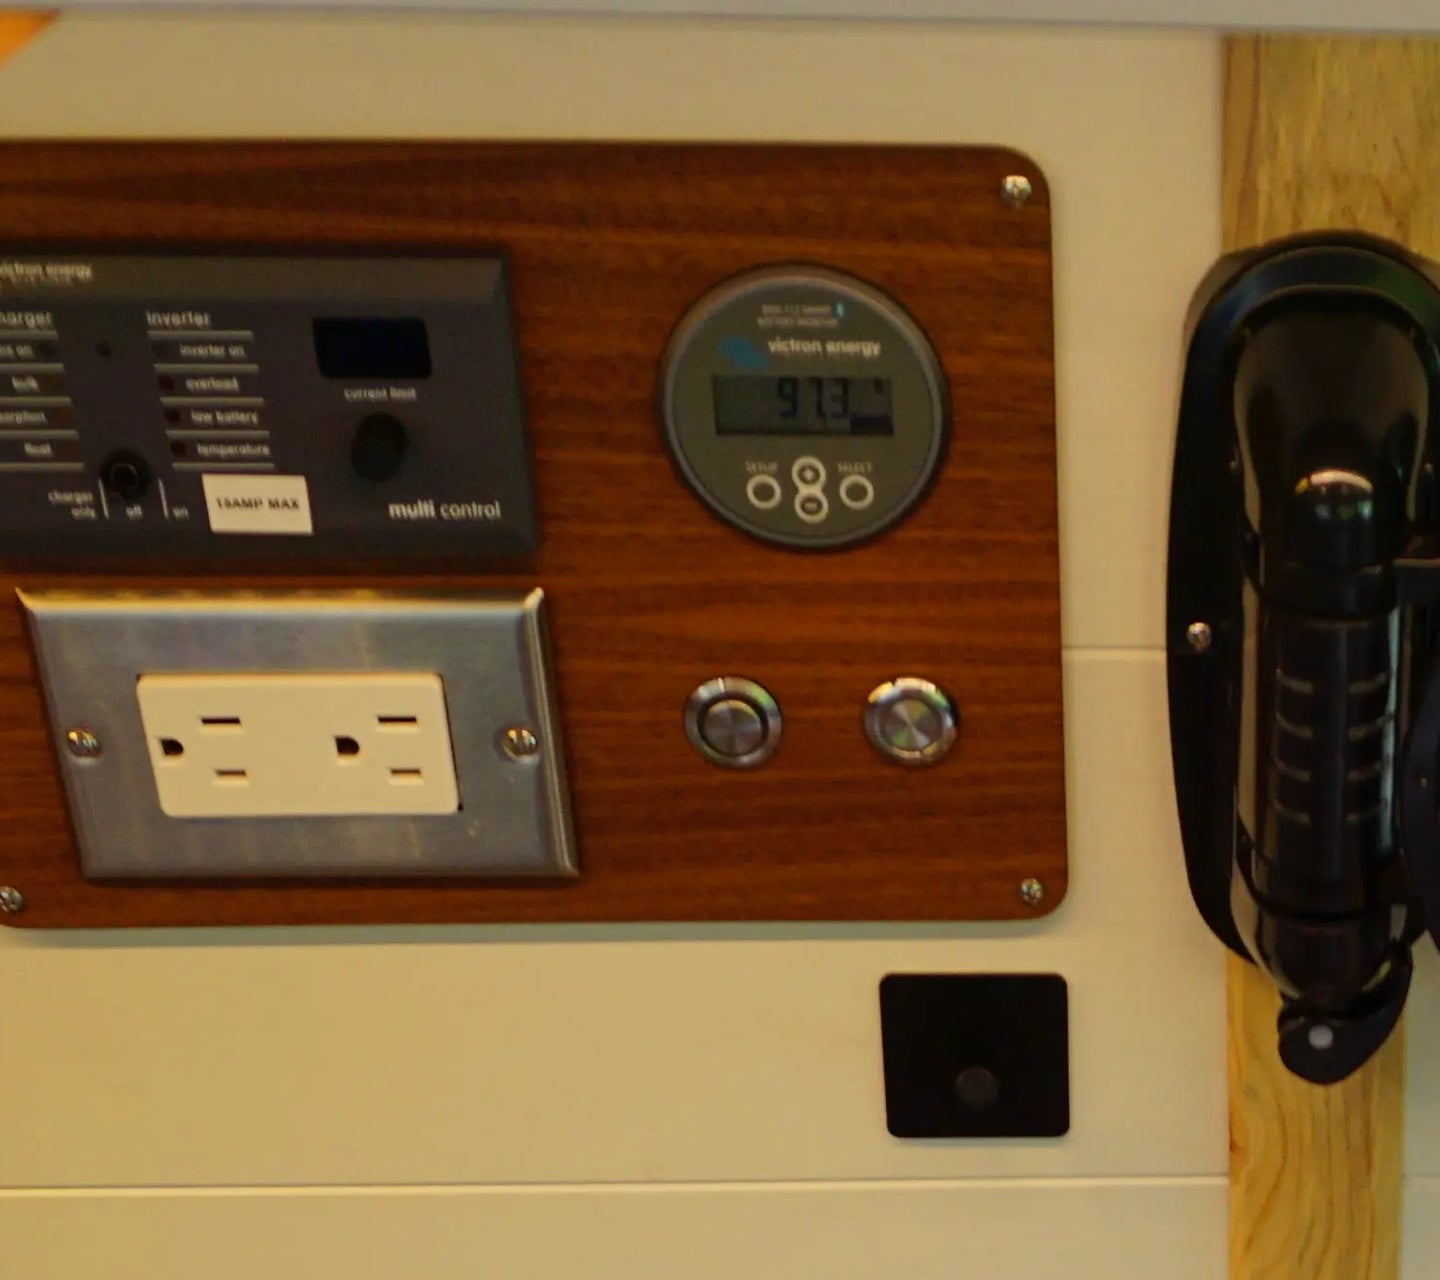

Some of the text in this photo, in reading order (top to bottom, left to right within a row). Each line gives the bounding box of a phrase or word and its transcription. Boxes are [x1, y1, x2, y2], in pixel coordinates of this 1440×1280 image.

[145, 309, 211, 327] inverter
[16, 344, 34, 358] on
[179, 343, 246, 358] inverter on
[767, 336, 822, 353] victron
[825, 340, 882, 358] energy
[185, 377, 240, 392] overload
[343, 386, 418, 402] current limit
[190, 409, 259, 426] low battery
[196, 443, 270, 458] temperature
[47, 490, 94, 505] charger
[267, 495, 301, 511] MAX
[70, 506, 97, 520] only
[125, 504, 143, 520] off
[172, 506, 189, 520] on
[387, 499, 502, 521] multi control
